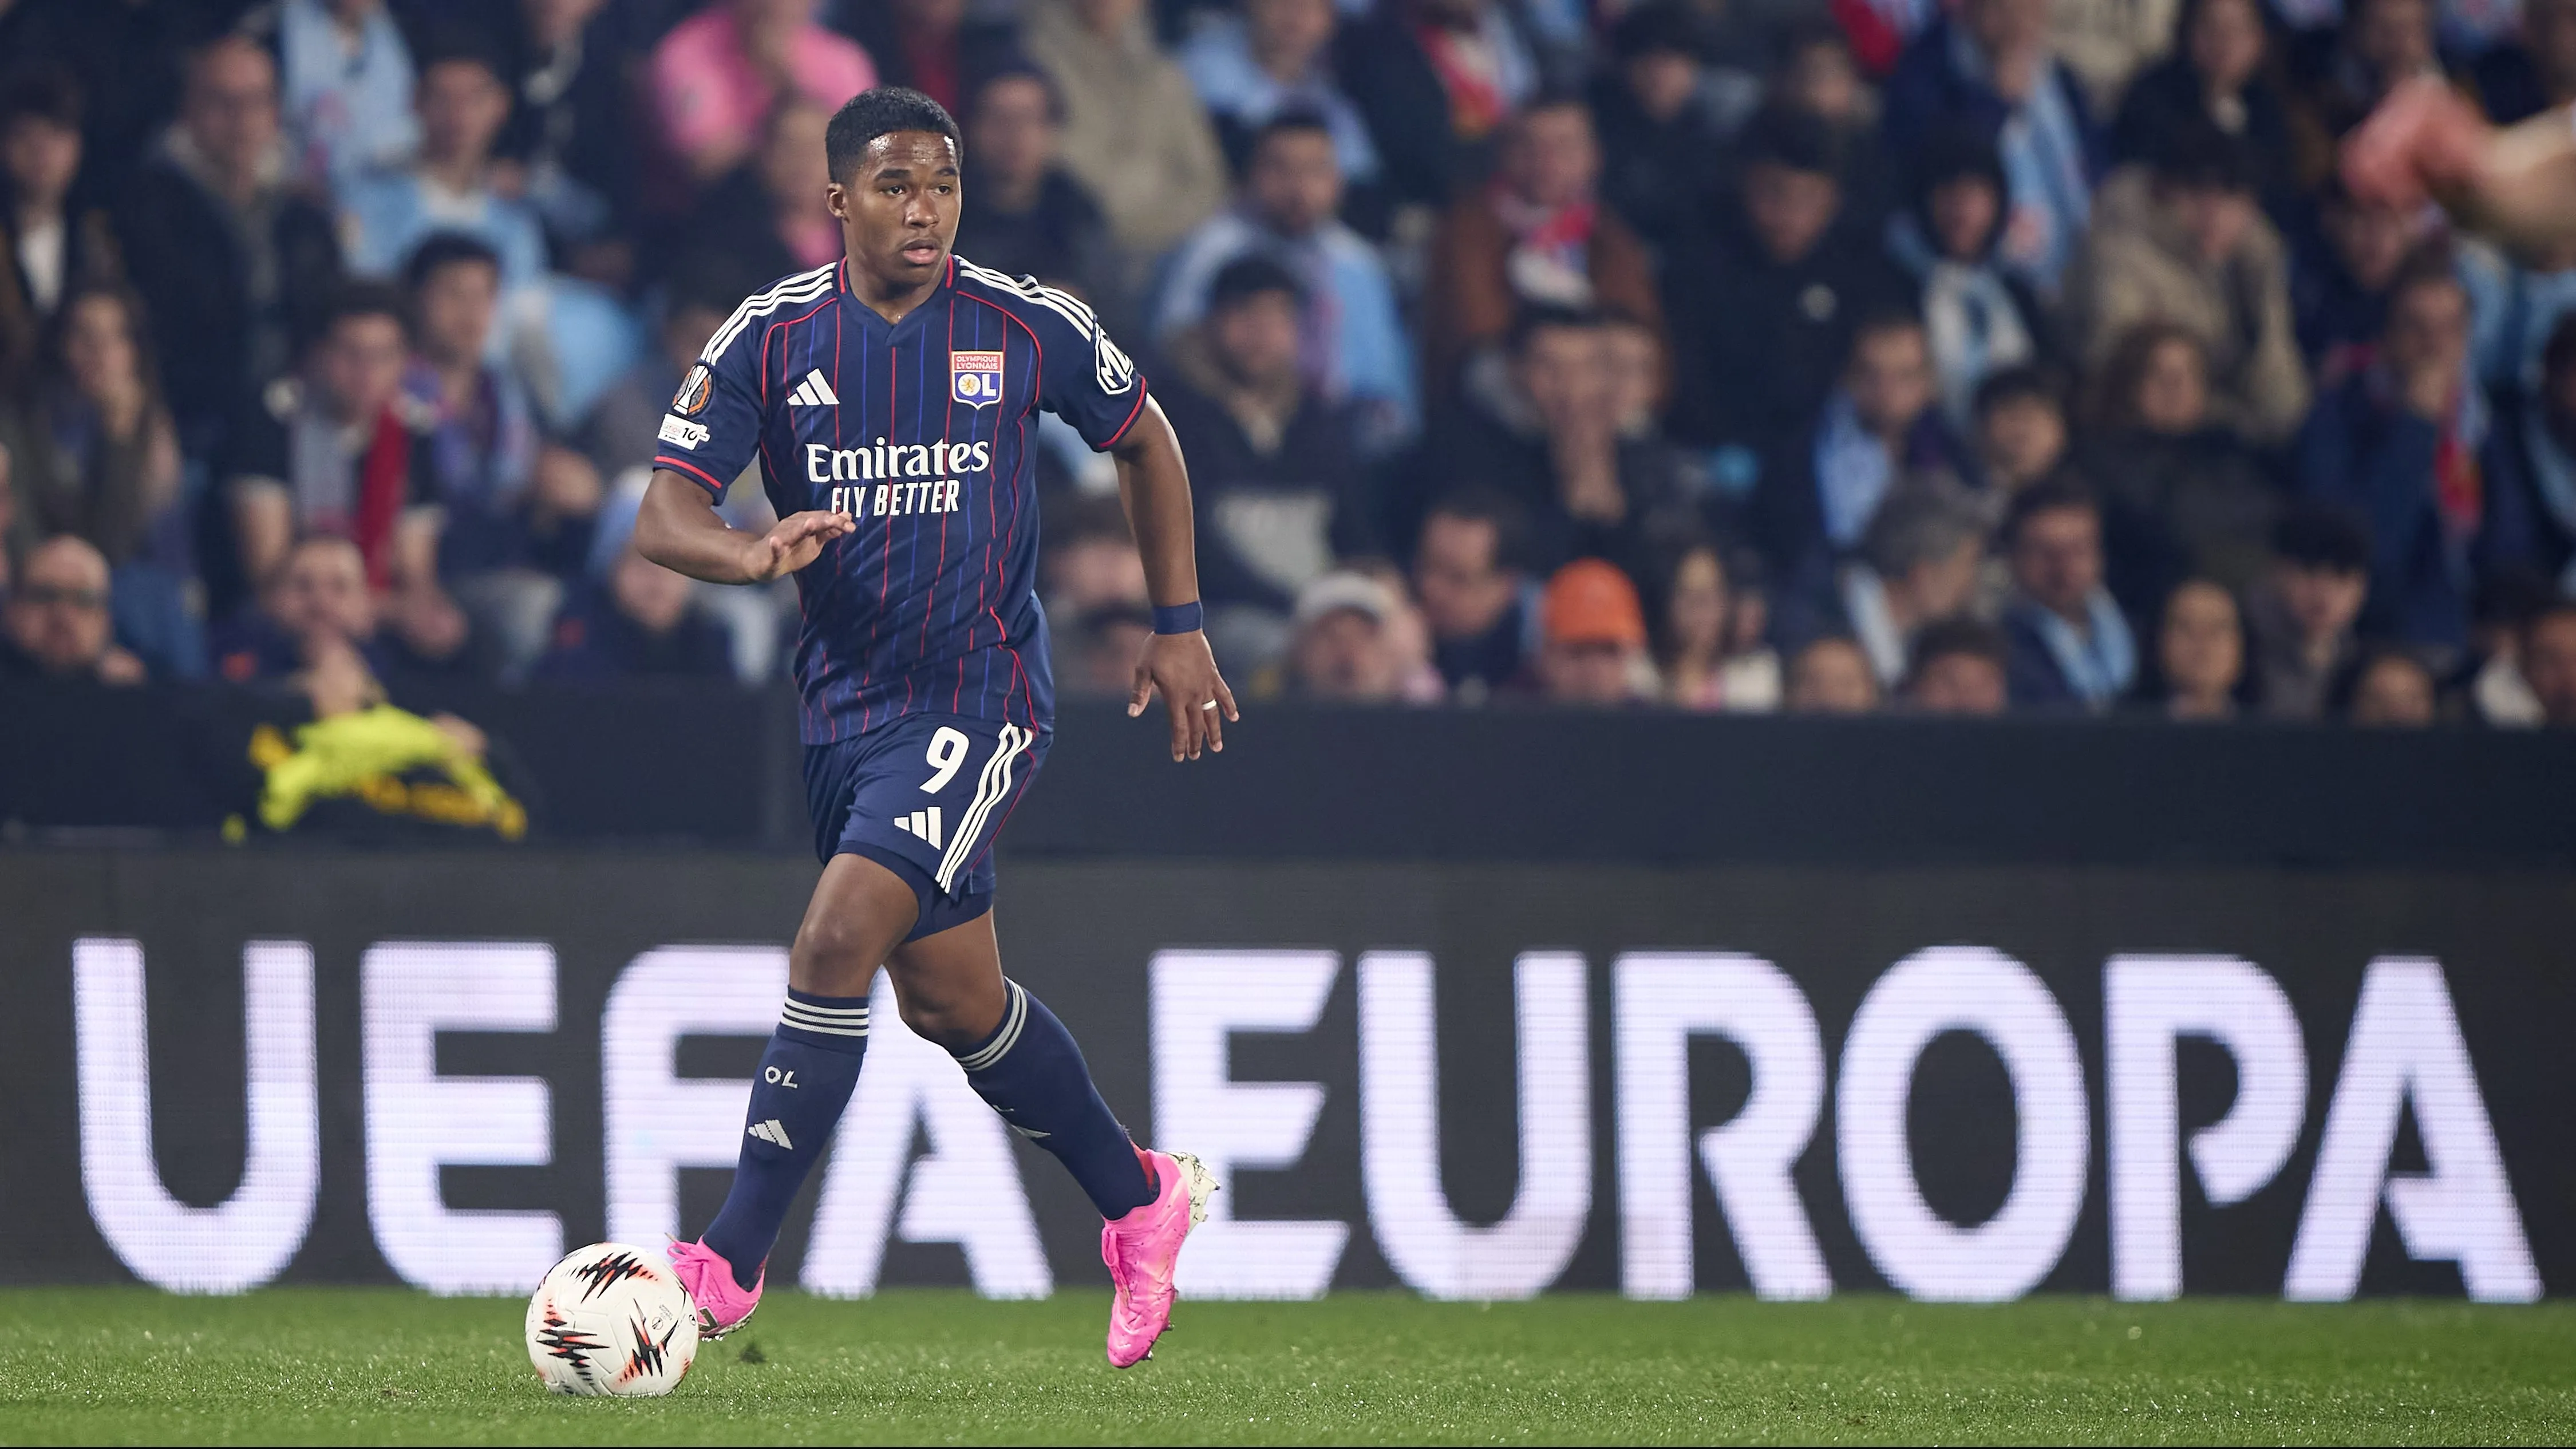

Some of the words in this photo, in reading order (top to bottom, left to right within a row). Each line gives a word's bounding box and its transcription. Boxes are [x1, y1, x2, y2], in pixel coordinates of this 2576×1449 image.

[956, 362, 998, 370] LYONNAIS
[958, 373, 997, 396] OL
[805, 436, 989, 483] Emirates
[873, 479, 960, 516] BETTER
[919, 725, 969, 794] 9
[765, 1066, 798, 1088] OL
[72, 938, 1053, 1298] UEFA
[1149, 946, 2545, 1303] EUROPA
